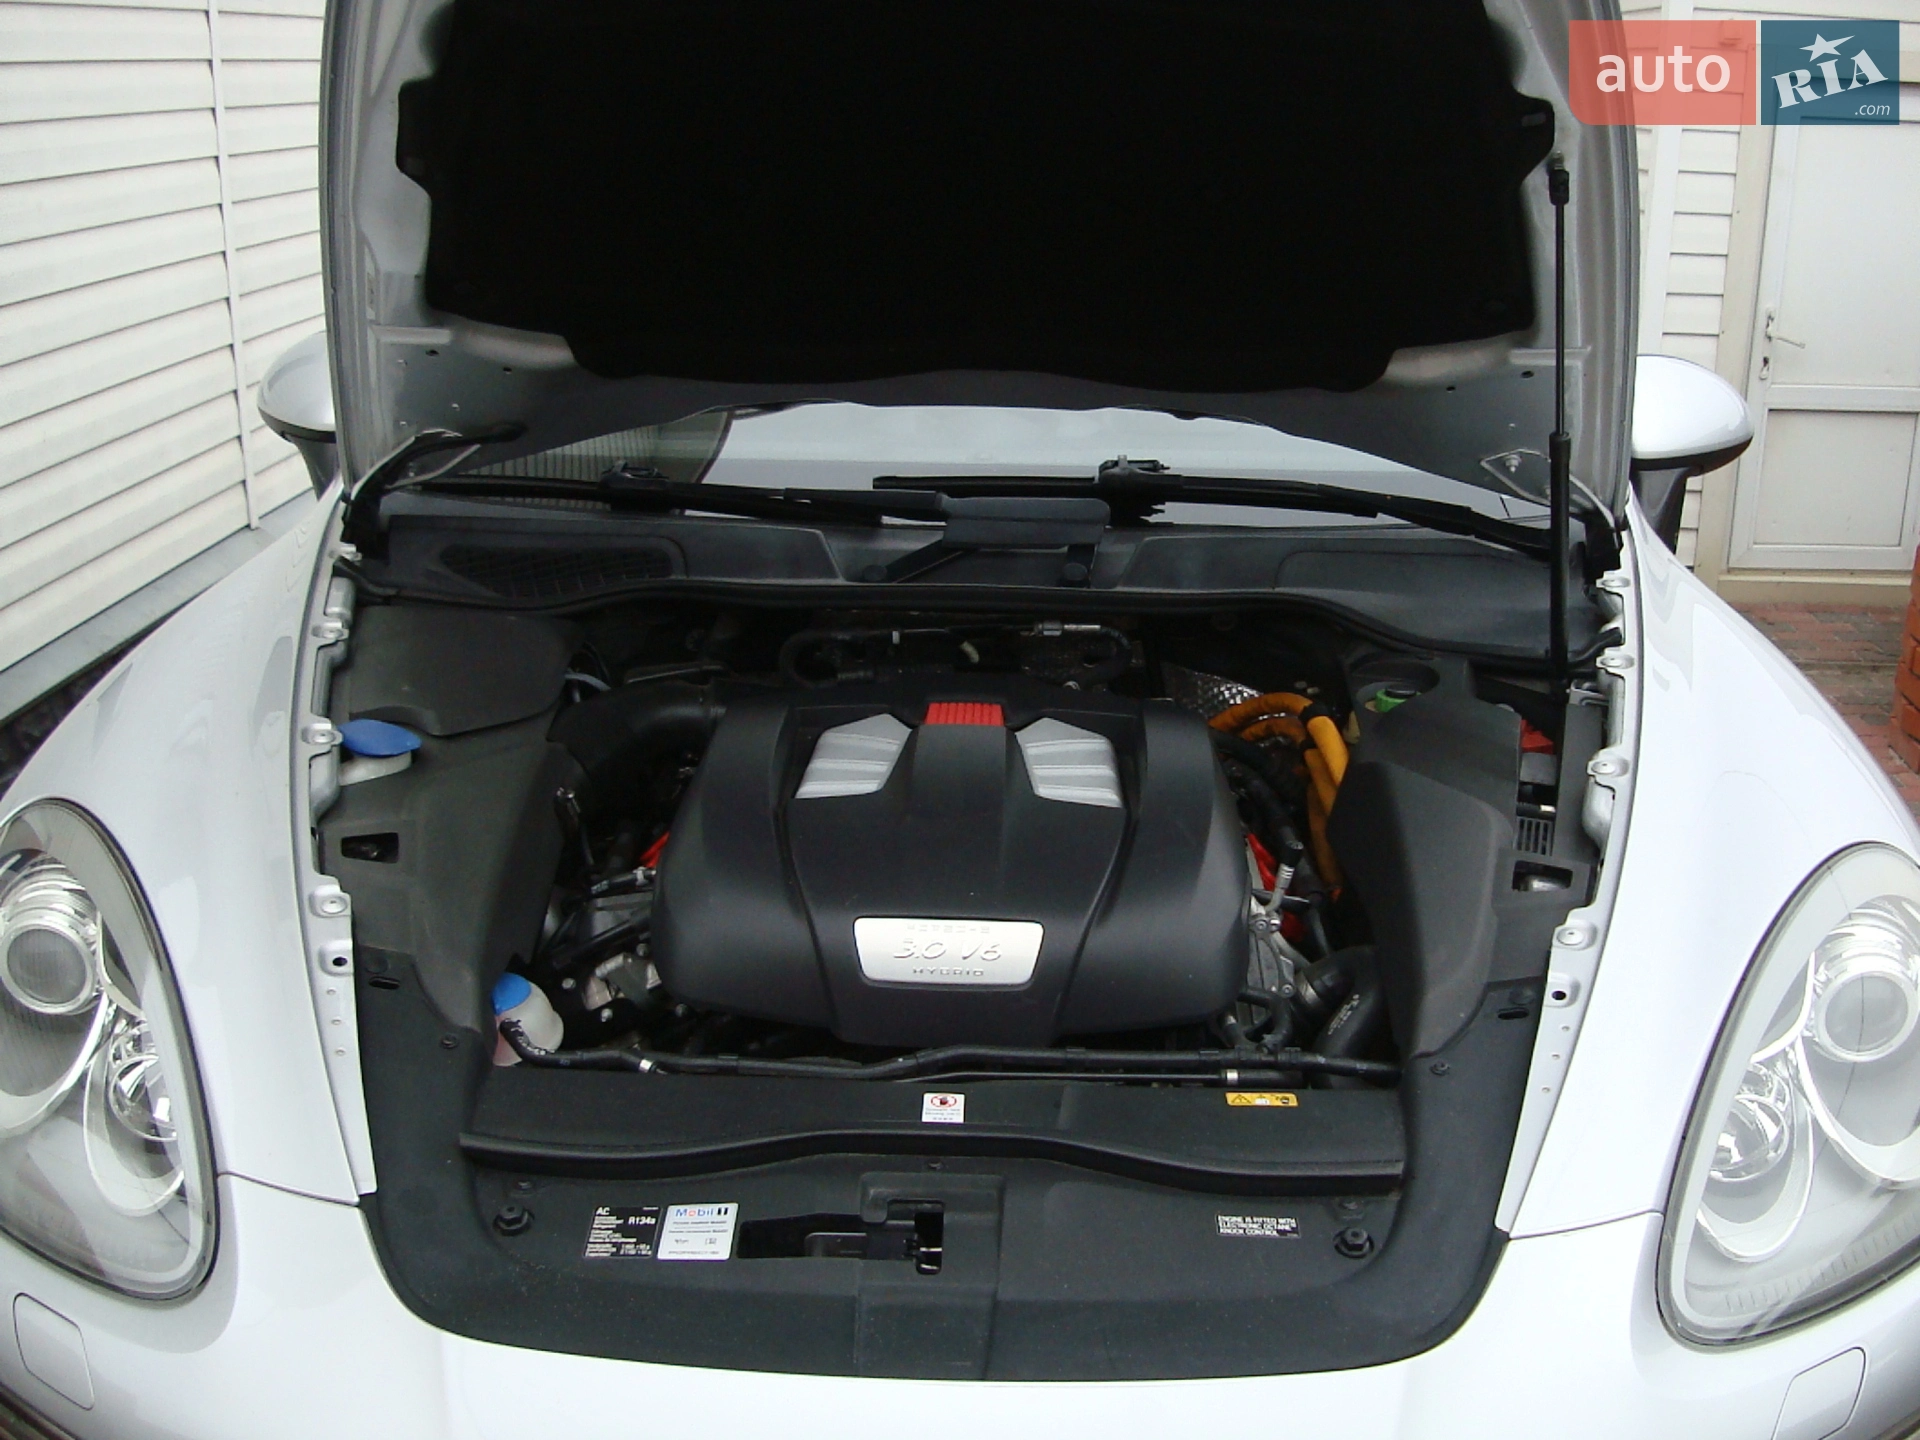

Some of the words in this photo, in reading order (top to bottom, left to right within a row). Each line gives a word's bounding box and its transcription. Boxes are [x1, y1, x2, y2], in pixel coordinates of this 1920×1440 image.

[893, 938, 947, 960] 3.0
[961, 942, 1002, 962] V6
[912, 966, 984, 977] HYBRID
[596, 1206, 611, 1215] AC
[675, 1207, 714, 1217] Mobil
[628, 1216, 656, 1225] R134a
